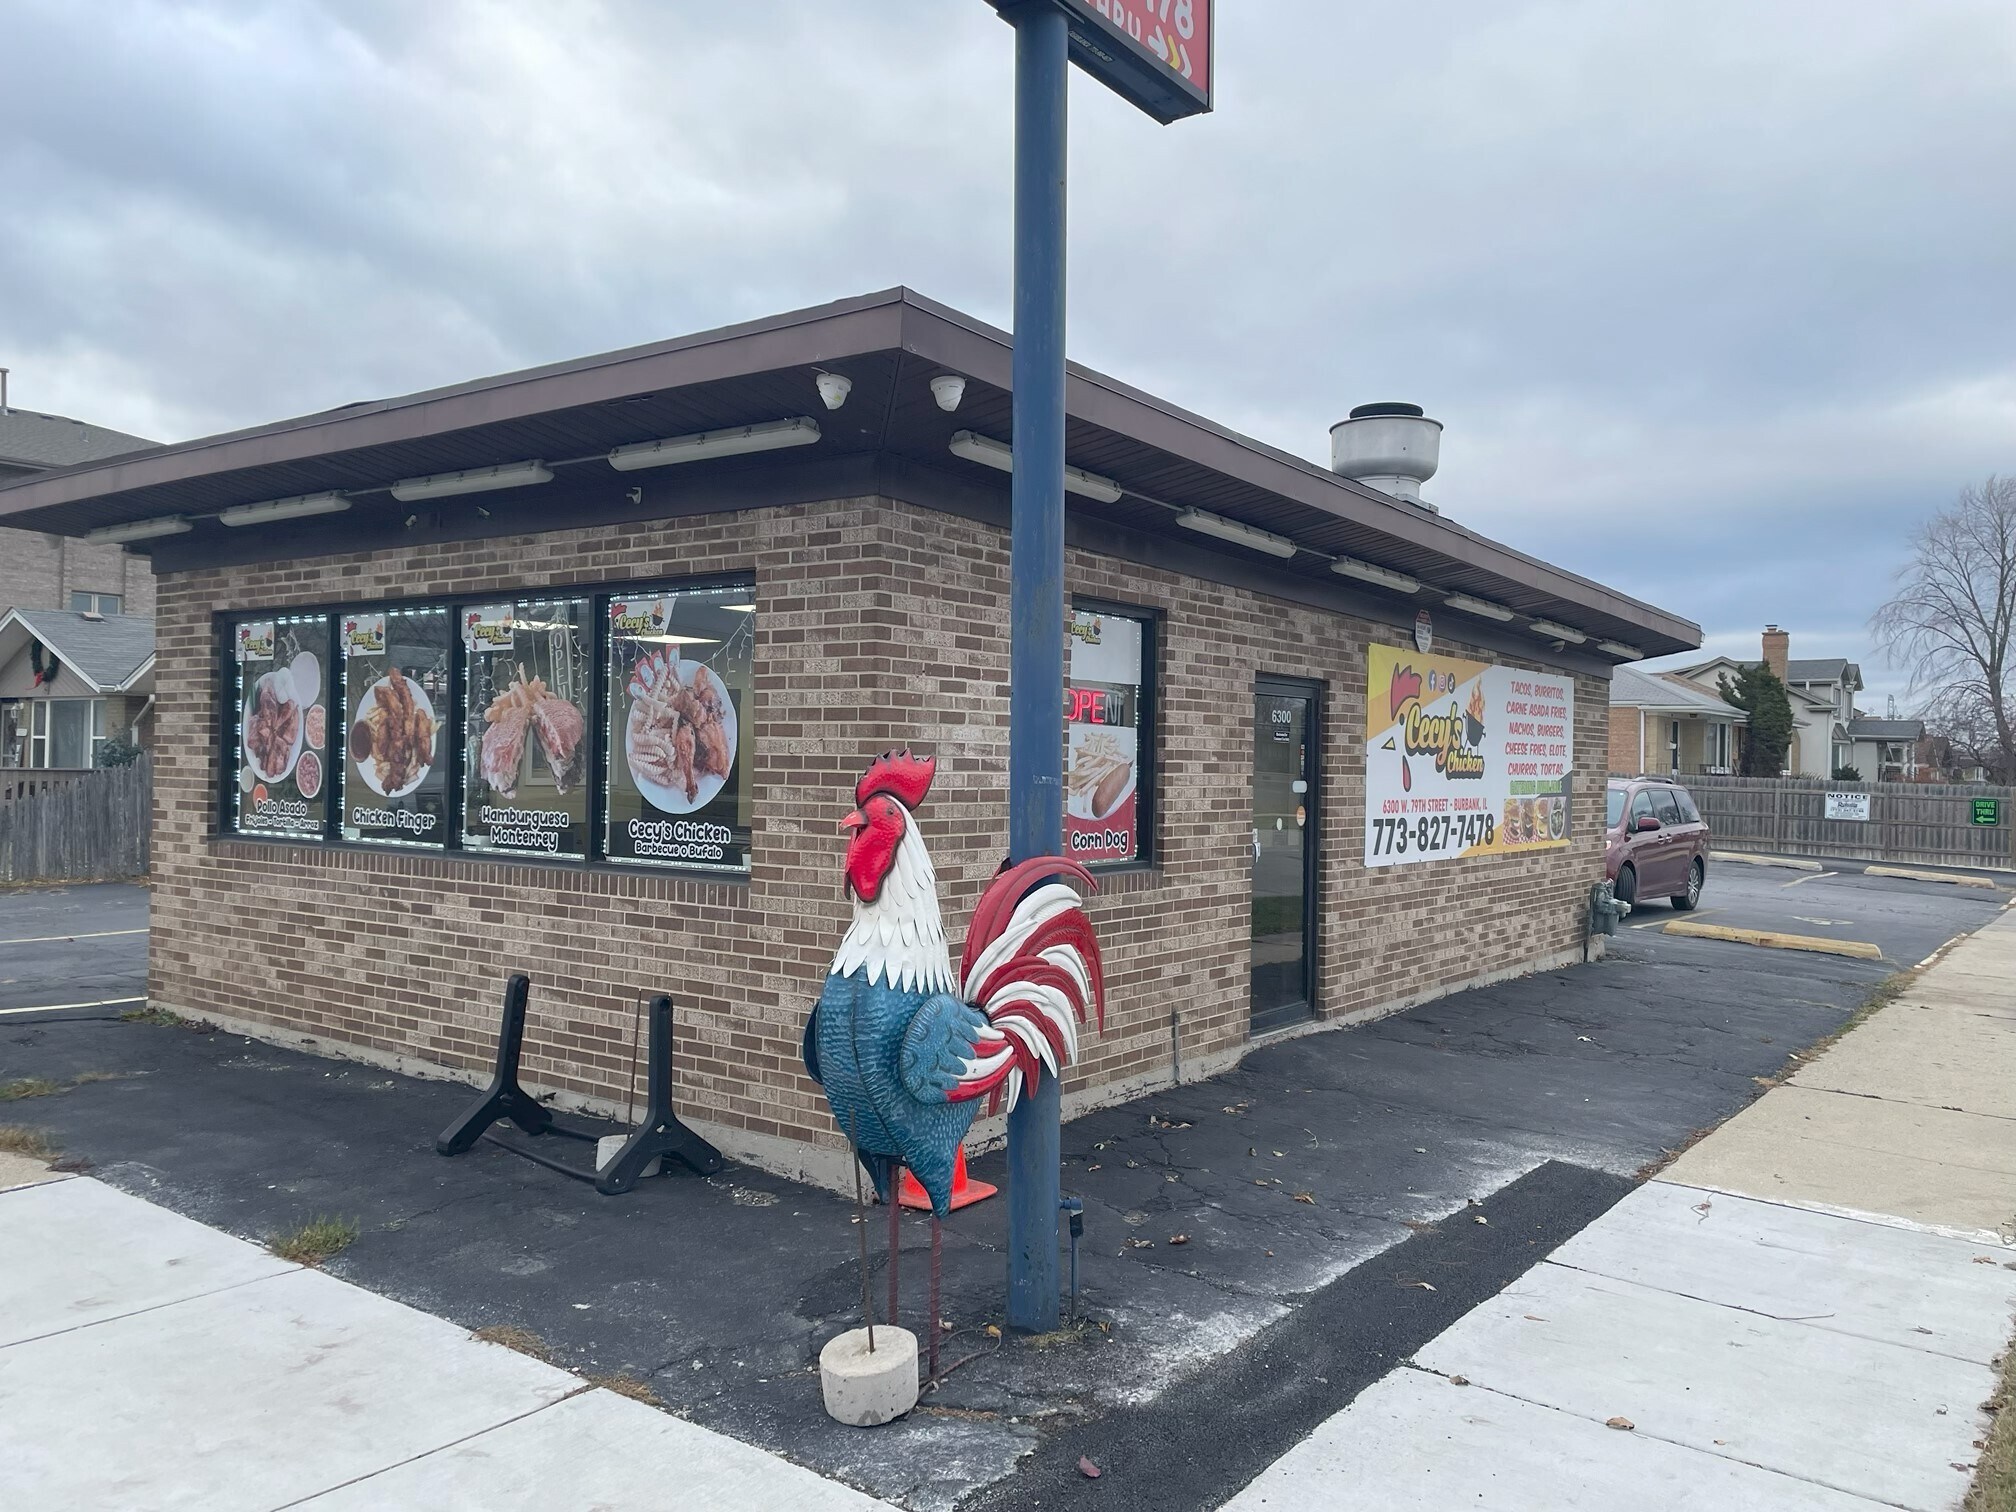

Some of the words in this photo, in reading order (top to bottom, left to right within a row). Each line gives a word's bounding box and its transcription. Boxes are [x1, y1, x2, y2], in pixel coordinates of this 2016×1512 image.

[474, 621, 501, 643] Cecy's
[620, 611, 650, 634] Cecy's
[641, 627, 664, 638] Chicken
[351, 628, 374, 649] Cecy's
[1511, 681, 1532, 698] TACOS,
[1534, 684, 1564, 701] BURRITOS,
[1068, 688, 1118, 723] OPEN
[1506, 701, 1528, 715] CARNE
[1529, 703, 1549, 717] ASADA
[1551, 705, 1567, 720] FRIES,
[1272, 710, 1291, 723] 6300
[1405, 702, 1463, 772] Cecy's
[1509, 722, 1535, 737] NACHOS,
[1537, 723, 1564, 739] BURGERS,
[1505, 742, 1528, 755] CHEESE
[1530, 743, 1547, 757] FRIES,
[1549, 744, 1567, 758] ELOTE,
[1446, 748, 1484, 778] Chicken
[1508, 763, 1538, 776] CHURROS,
[1541, 763, 1564, 775] TORTAS.
[257, 798, 278, 814] Pollo
[279, 799, 307, 816] Asado
[1382, 800, 1399, 814] 6300
[1401, 799, 1410, 813] W.
[1411, 799, 1426, 813] 79TH
[1427, 799, 1448, 812] STREET
[1454, 798, 1481, 811] BURBANK,
[1482, 798, 1488, 810] IL
[299, 818, 319, 830] Arroz
[353, 806, 397, 826] Chicken
[397, 809, 436, 835] Finger
[481, 805, 569, 830] Hamburguesa
[490, 825, 559, 852] Monterrey
[628, 818, 672, 843] Cecy's
[674, 820, 731, 844] Chicken
[1071, 830, 1103, 851] Corn
[1104, 828, 1129, 854] Dog
[1373, 813, 1494, 855] 773-827-7478
[634, 840, 680, 857] Barbecue
[680, 846, 688, 857] o
[688, 843, 723, 860] Bufalo
